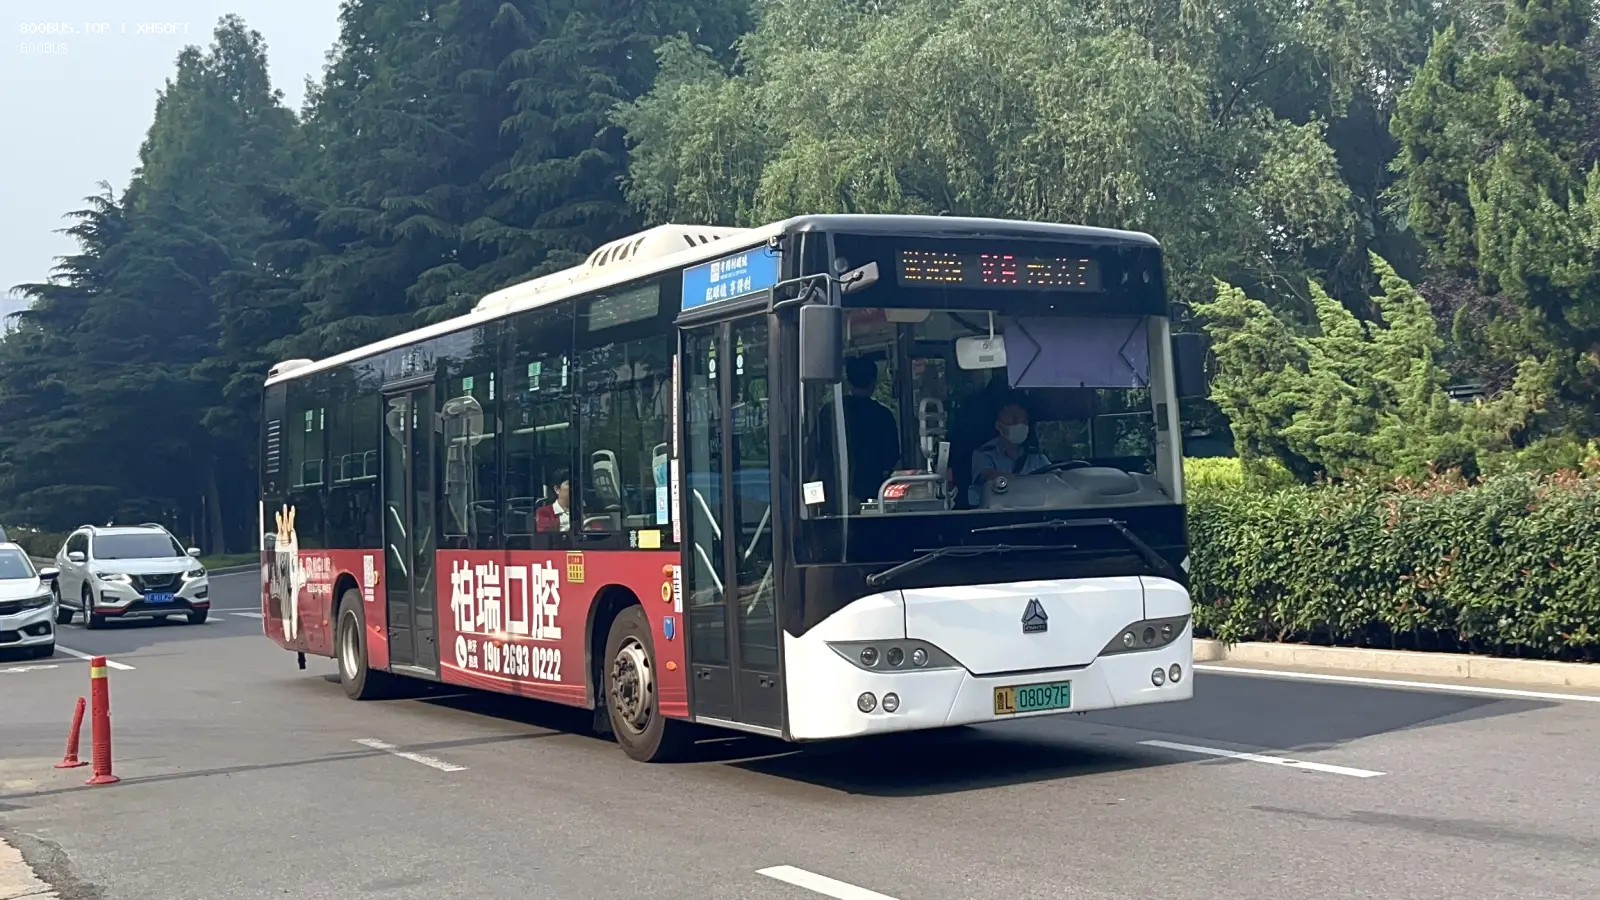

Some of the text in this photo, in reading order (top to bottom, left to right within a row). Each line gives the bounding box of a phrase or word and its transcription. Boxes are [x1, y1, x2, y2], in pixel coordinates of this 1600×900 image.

[451, 560, 561, 639] 柏瑞口腔
[483, 640, 562, 682] 190 2693 0222
